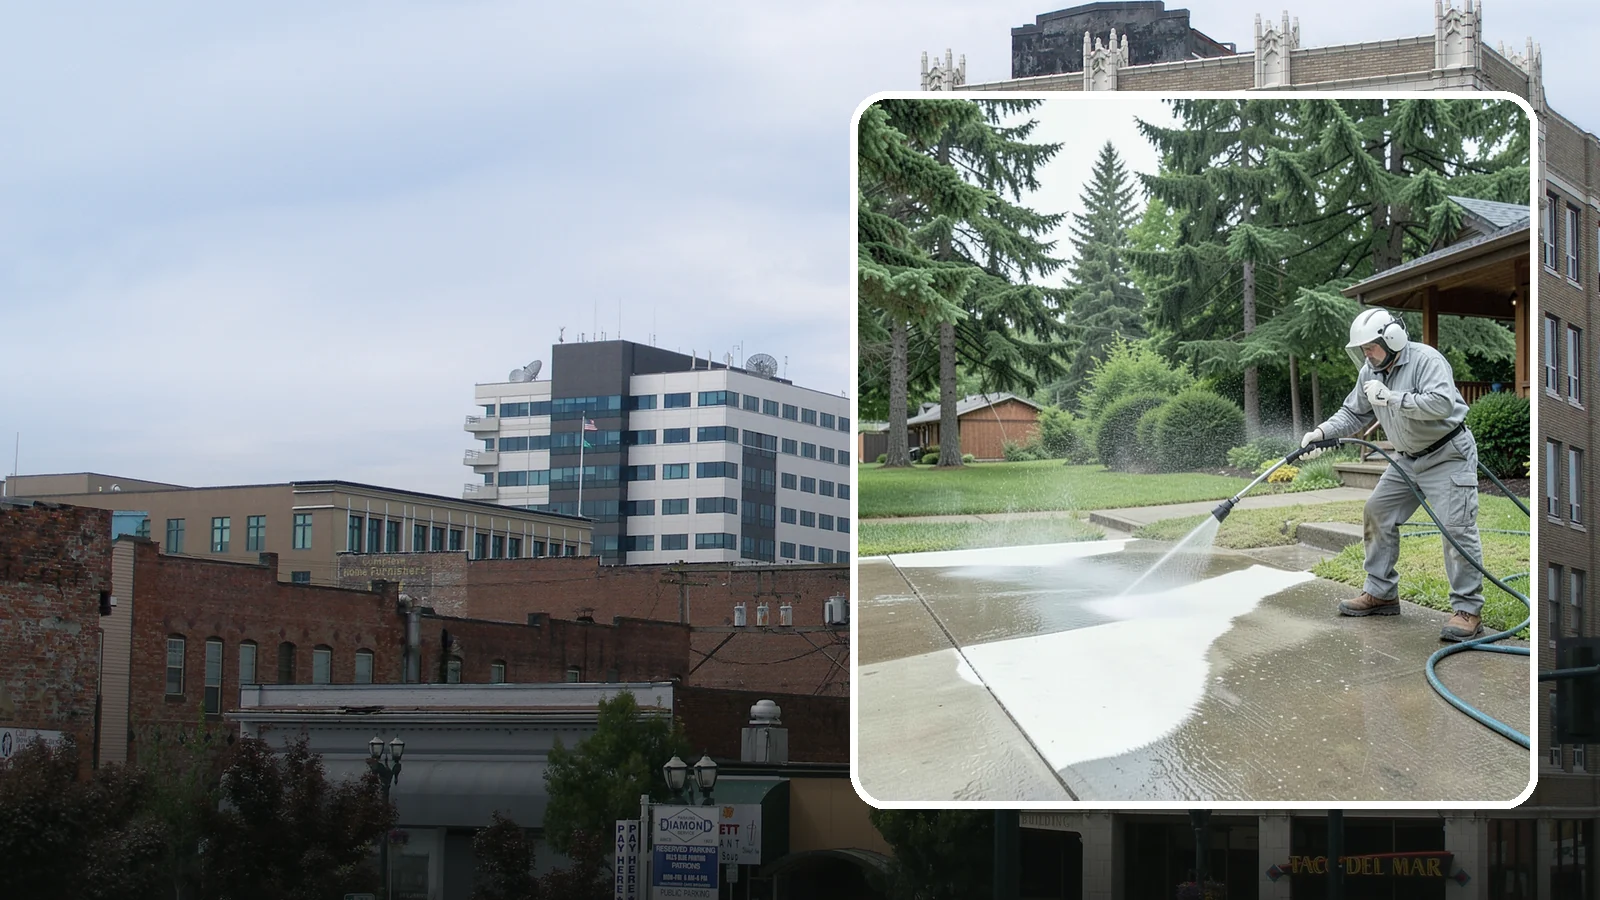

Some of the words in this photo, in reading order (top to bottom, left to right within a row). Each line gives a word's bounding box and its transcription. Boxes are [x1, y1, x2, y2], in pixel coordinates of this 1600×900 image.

[370, 566, 427, 577] Furnishers
[660, 818, 713, 832] DIAMOND
[1022, 815, 1070, 828] BUILDING
[617, 825, 625, 852] PAY
[656, 845, 687, 853] RESERVED
[721, 851, 739, 862] Soup
[671, 862, 701, 870] PATRONS
[1346, 857, 1385, 875] DEL
[1393, 858, 1443, 878] MAR
[616, 856, 624, 893] HERE
[628, 855, 636, 893] HERE
[660, 888, 682, 897] PUBLIC
[684, 889, 710, 898] PARKING
